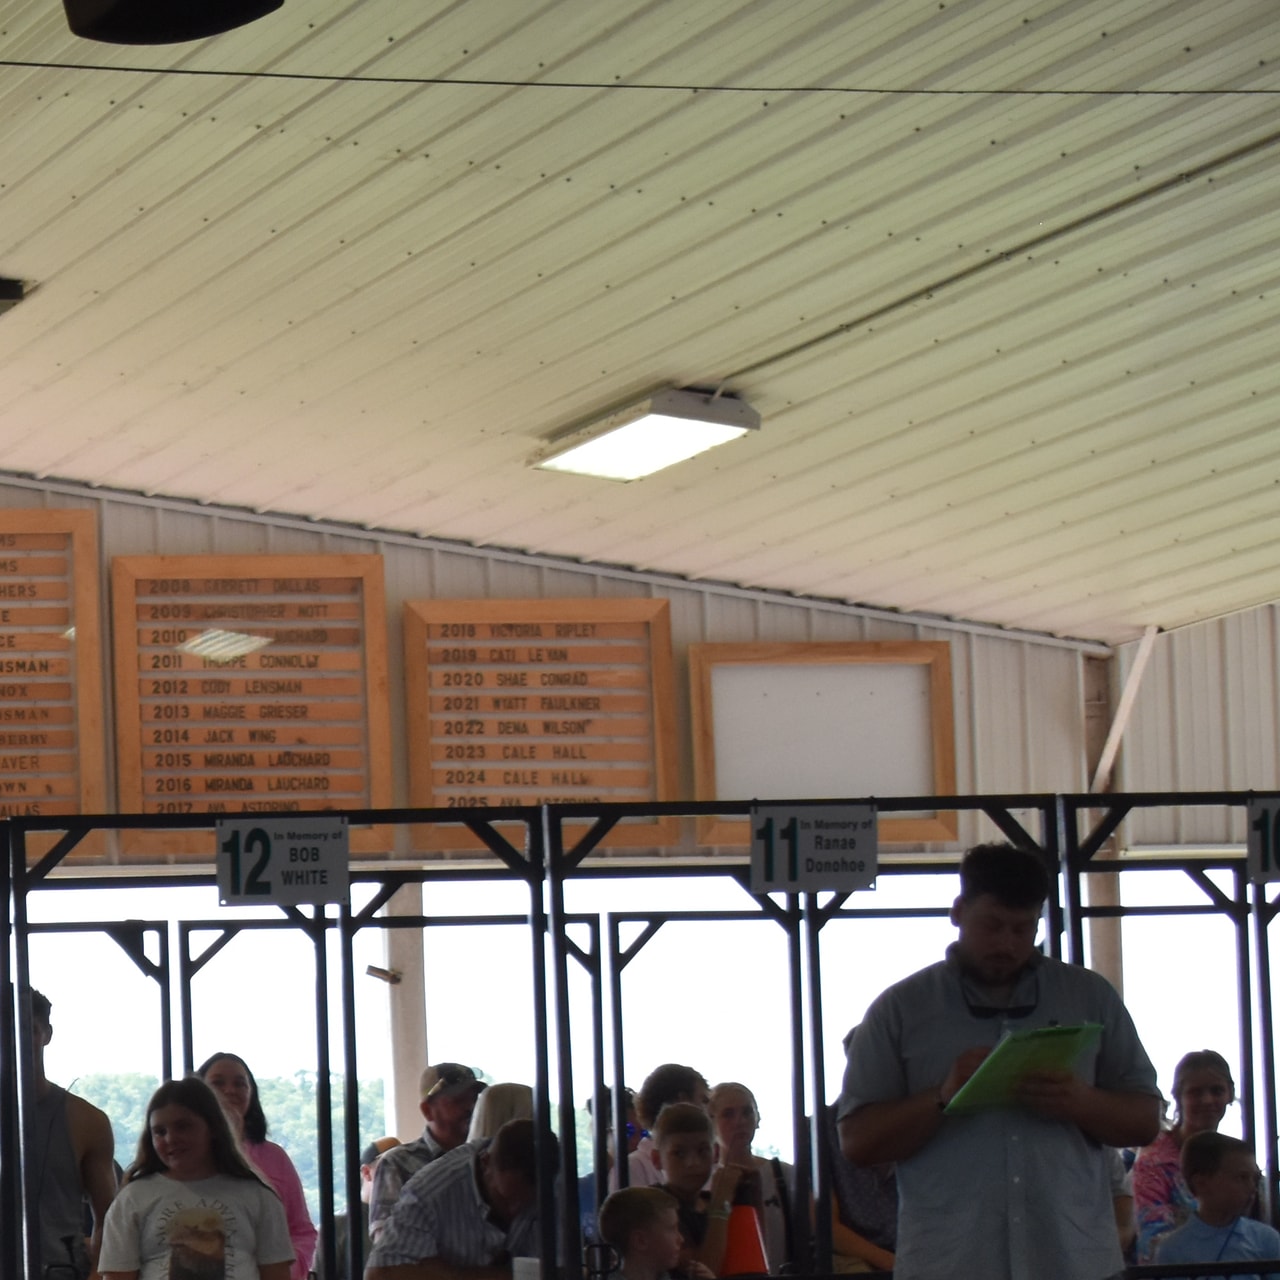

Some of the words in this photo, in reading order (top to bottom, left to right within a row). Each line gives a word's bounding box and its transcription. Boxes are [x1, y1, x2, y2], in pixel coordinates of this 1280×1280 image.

[442, 673, 484, 686] 2020
[496, 673, 528, 686] SHAE
[540, 672, 588, 686] CONRAD
[151, 681, 189, 695] 2012
[201, 681, 232, 695] CODY
[245, 680, 303, 694] LENSMAN
[443, 698, 480, 710] 2021
[153, 706, 190, 719] 2013
[203, 706, 246, 719] MAGGIE
[153, 730, 190, 743] 2014
[203, 730, 234, 743] JACK
[248, 730, 277, 743] WING
[445, 745, 486, 759] 2023
[502, 746, 537, 760] CALE
[552, 746, 587, 760] HALL
[155, 778, 192, 792] 2016
[205, 778, 254, 791] MIRANDA
[268, 777, 330, 790] LAUCHARD
[445, 771, 487, 785] 2024
[503, 771, 539, 785] CALE
[800, 820, 811, 829] In
[814, 820, 858, 831] Memory
[861, 819, 873, 829] of
[274, 832, 284, 840] In
[287, 831, 328, 841] Memory
[332, 831, 343, 840] of
[814, 835, 856, 850] Ranae
[289, 847, 320, 863] BOB
[755, 817, 798, 882] 11
[221, 827, 272, 896] 12
[806, 857, 865, 872] Donohoe
[281, 869, 328, 886] WHITE
